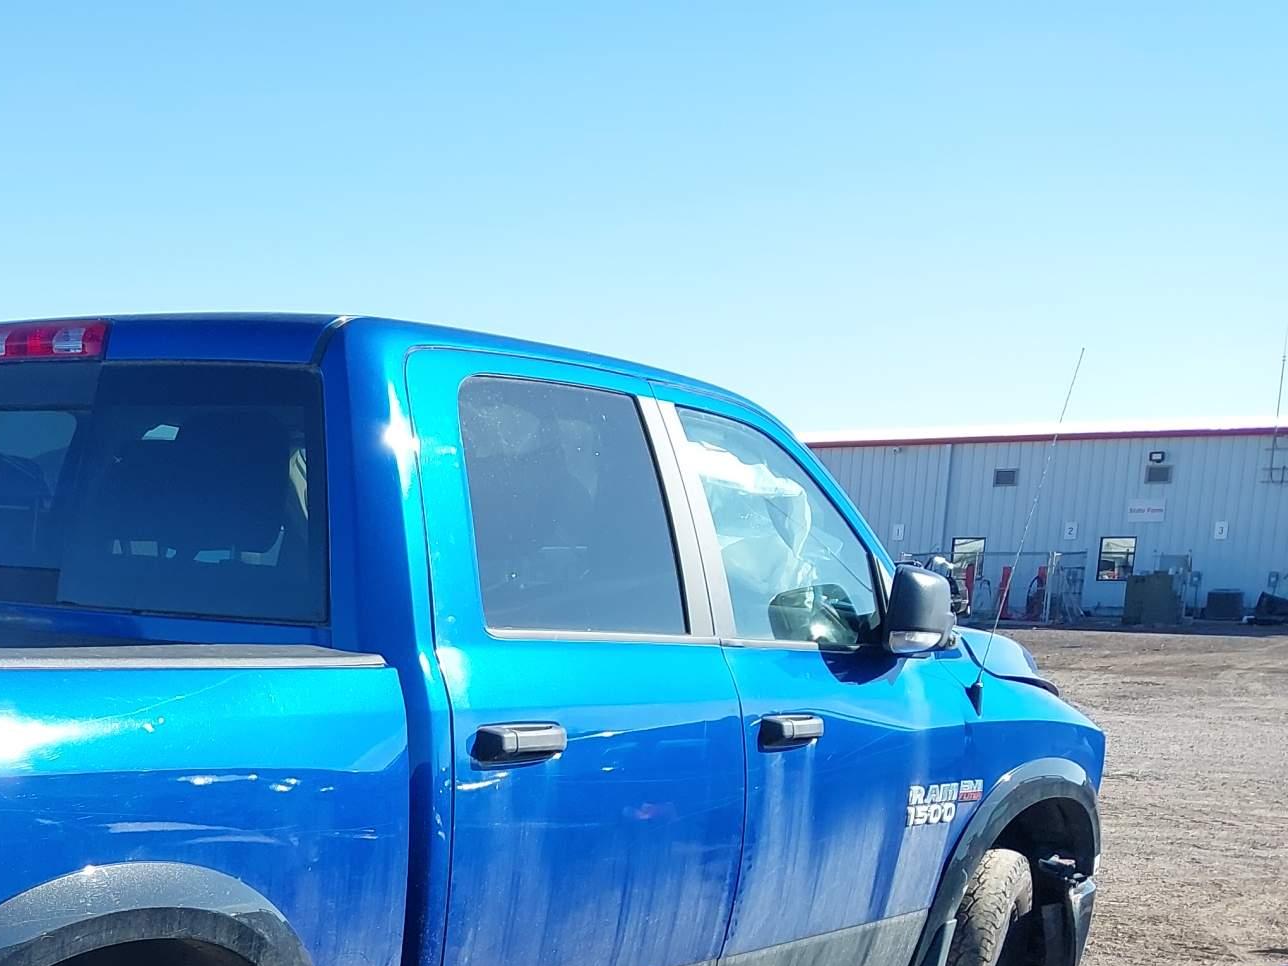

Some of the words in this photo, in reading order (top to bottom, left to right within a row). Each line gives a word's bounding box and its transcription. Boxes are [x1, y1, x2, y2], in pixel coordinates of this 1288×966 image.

[1067, 526, 1074, 536] 2
[1218, 526, 1225, 535] 3
[908, 782, 959, 805] RAM
[906, 802, 956, 827] 1500
